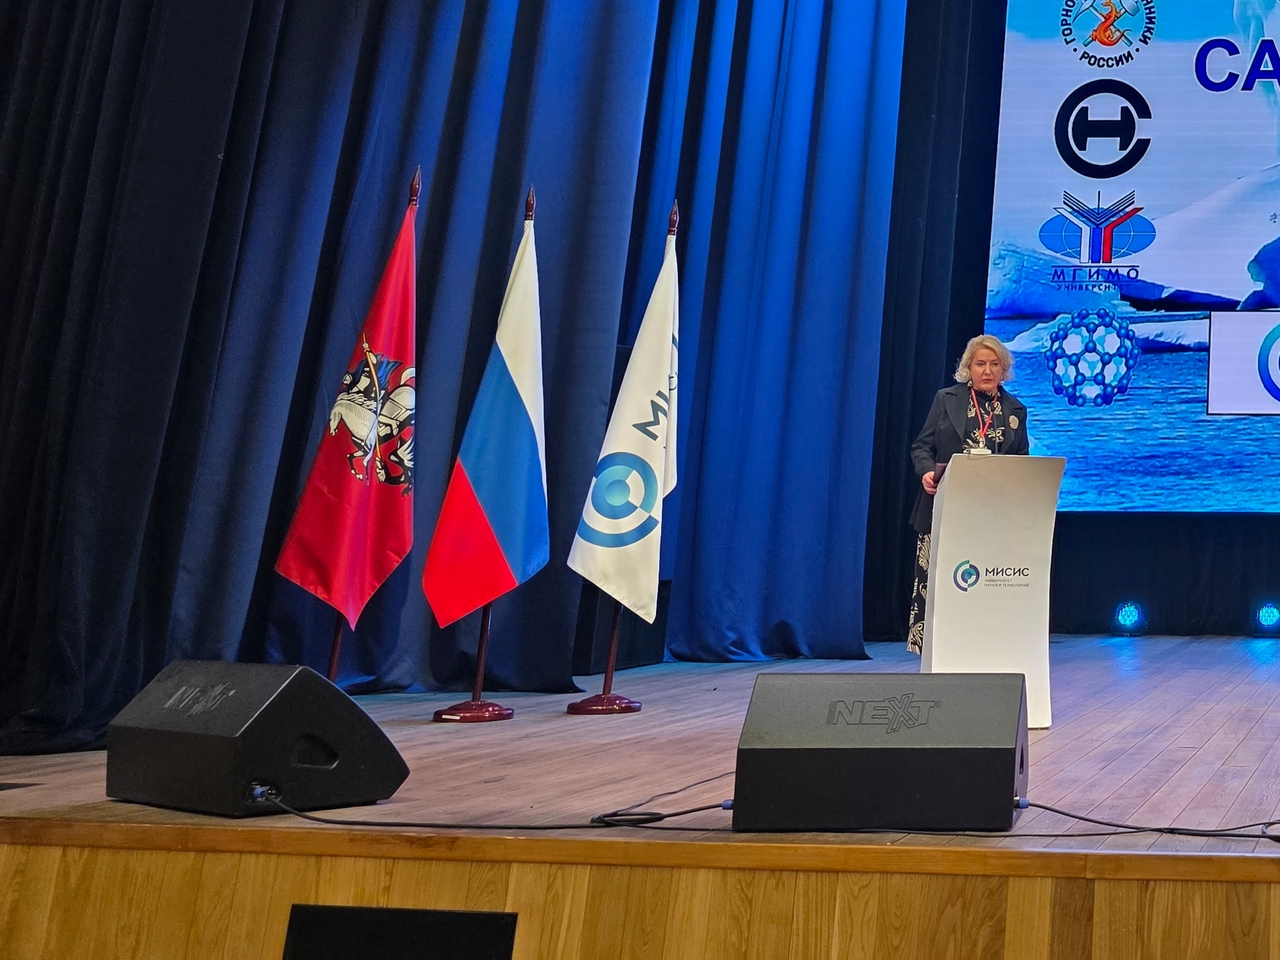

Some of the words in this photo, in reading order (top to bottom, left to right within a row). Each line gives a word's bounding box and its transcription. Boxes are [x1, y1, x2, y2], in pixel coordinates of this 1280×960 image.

[1079, 50, 1135, 69] РОССИИ
[1050, 267, 1140, 281] МГИМО
[984, 567, 1030, 577] МИСИС
[826, 692, 942, 734] NEXT
